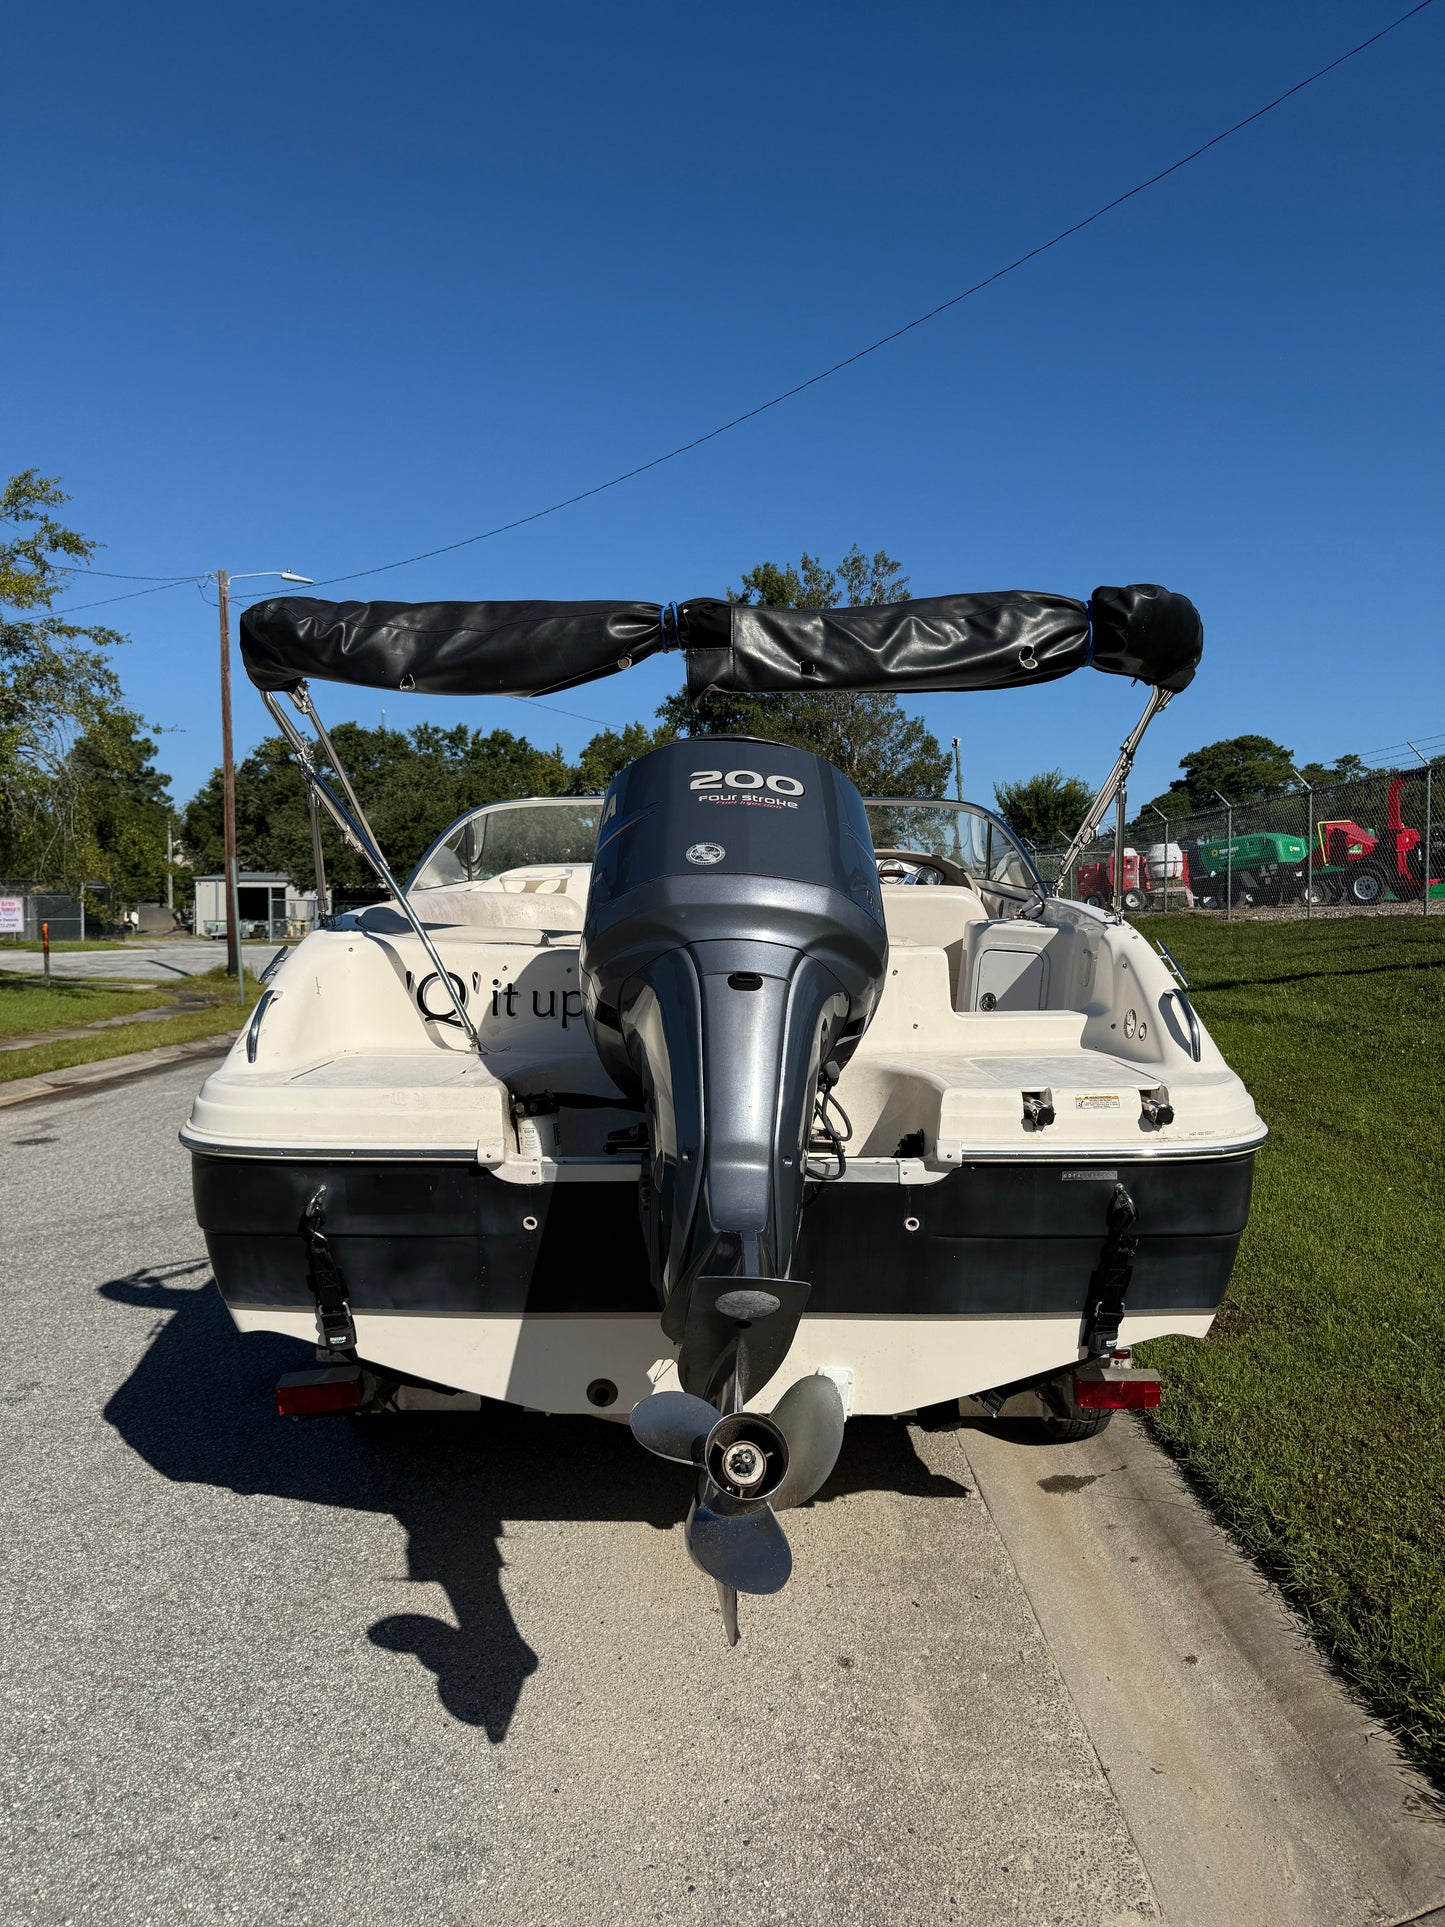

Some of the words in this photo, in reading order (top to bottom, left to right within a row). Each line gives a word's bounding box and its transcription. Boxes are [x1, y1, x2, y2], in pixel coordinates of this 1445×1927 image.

[689, 770, 805, 796] 200
[492, 979, 519, 1017] it
[532, 990, 584, 1028] up
